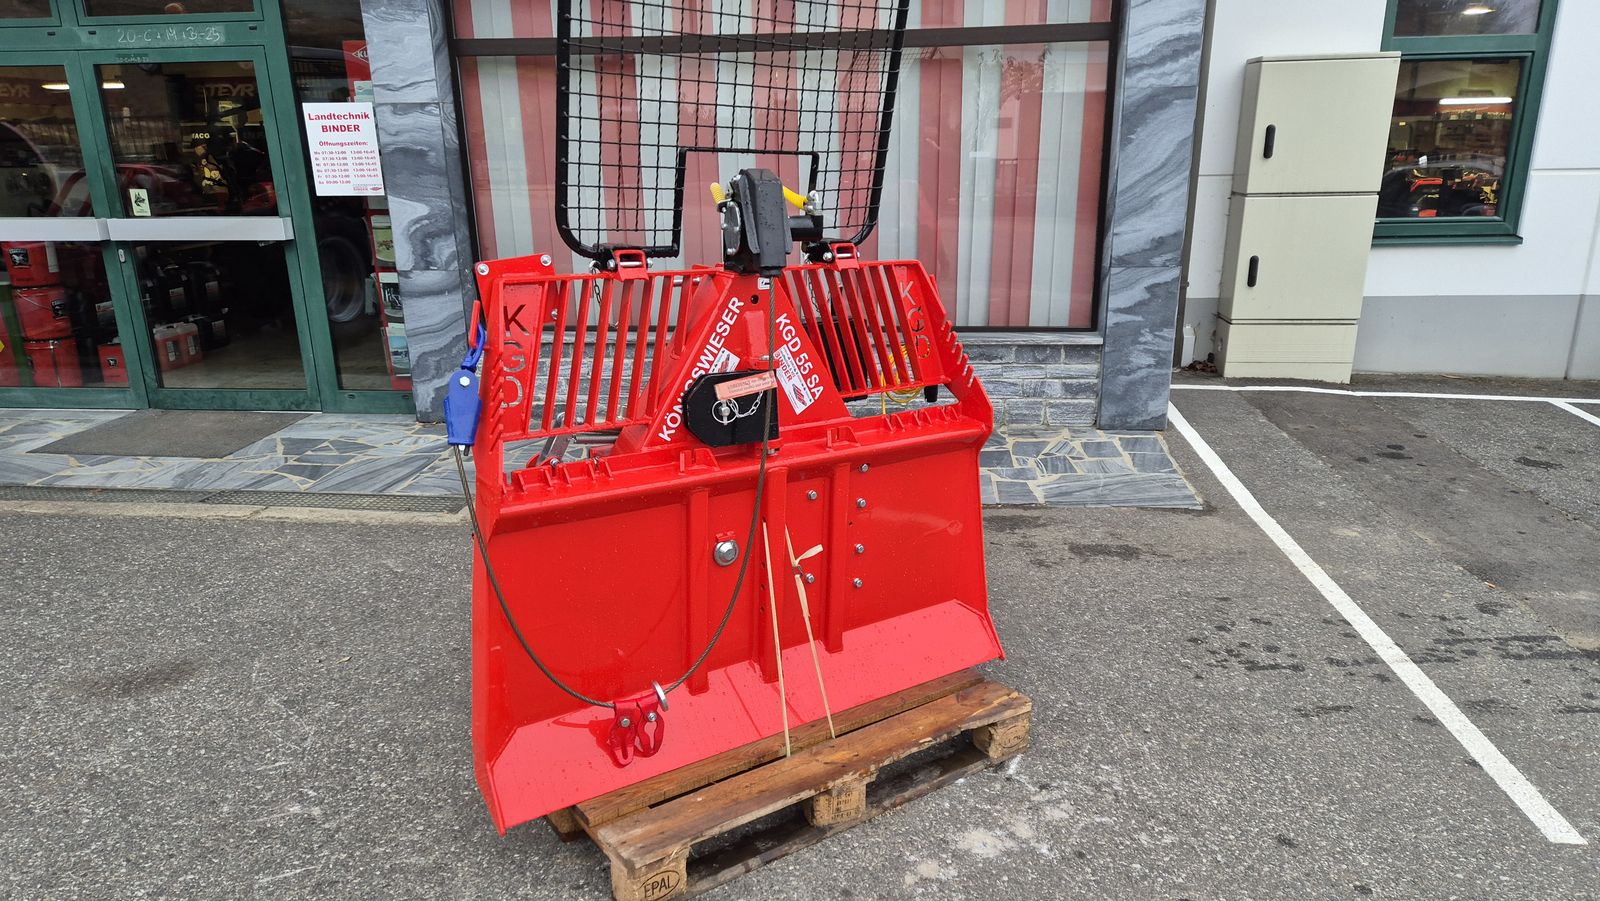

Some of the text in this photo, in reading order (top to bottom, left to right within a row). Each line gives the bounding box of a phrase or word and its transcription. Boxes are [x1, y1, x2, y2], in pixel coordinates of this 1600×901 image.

[308, 112, 370, 120] Landtechnik
[321, 124, 361, 133] BINDER
[776, 312, 824, 400] KGD 55 SA
[658, 296, 745, 442] KÖSWIESER
[643, 874, 674, 899] EPAL
